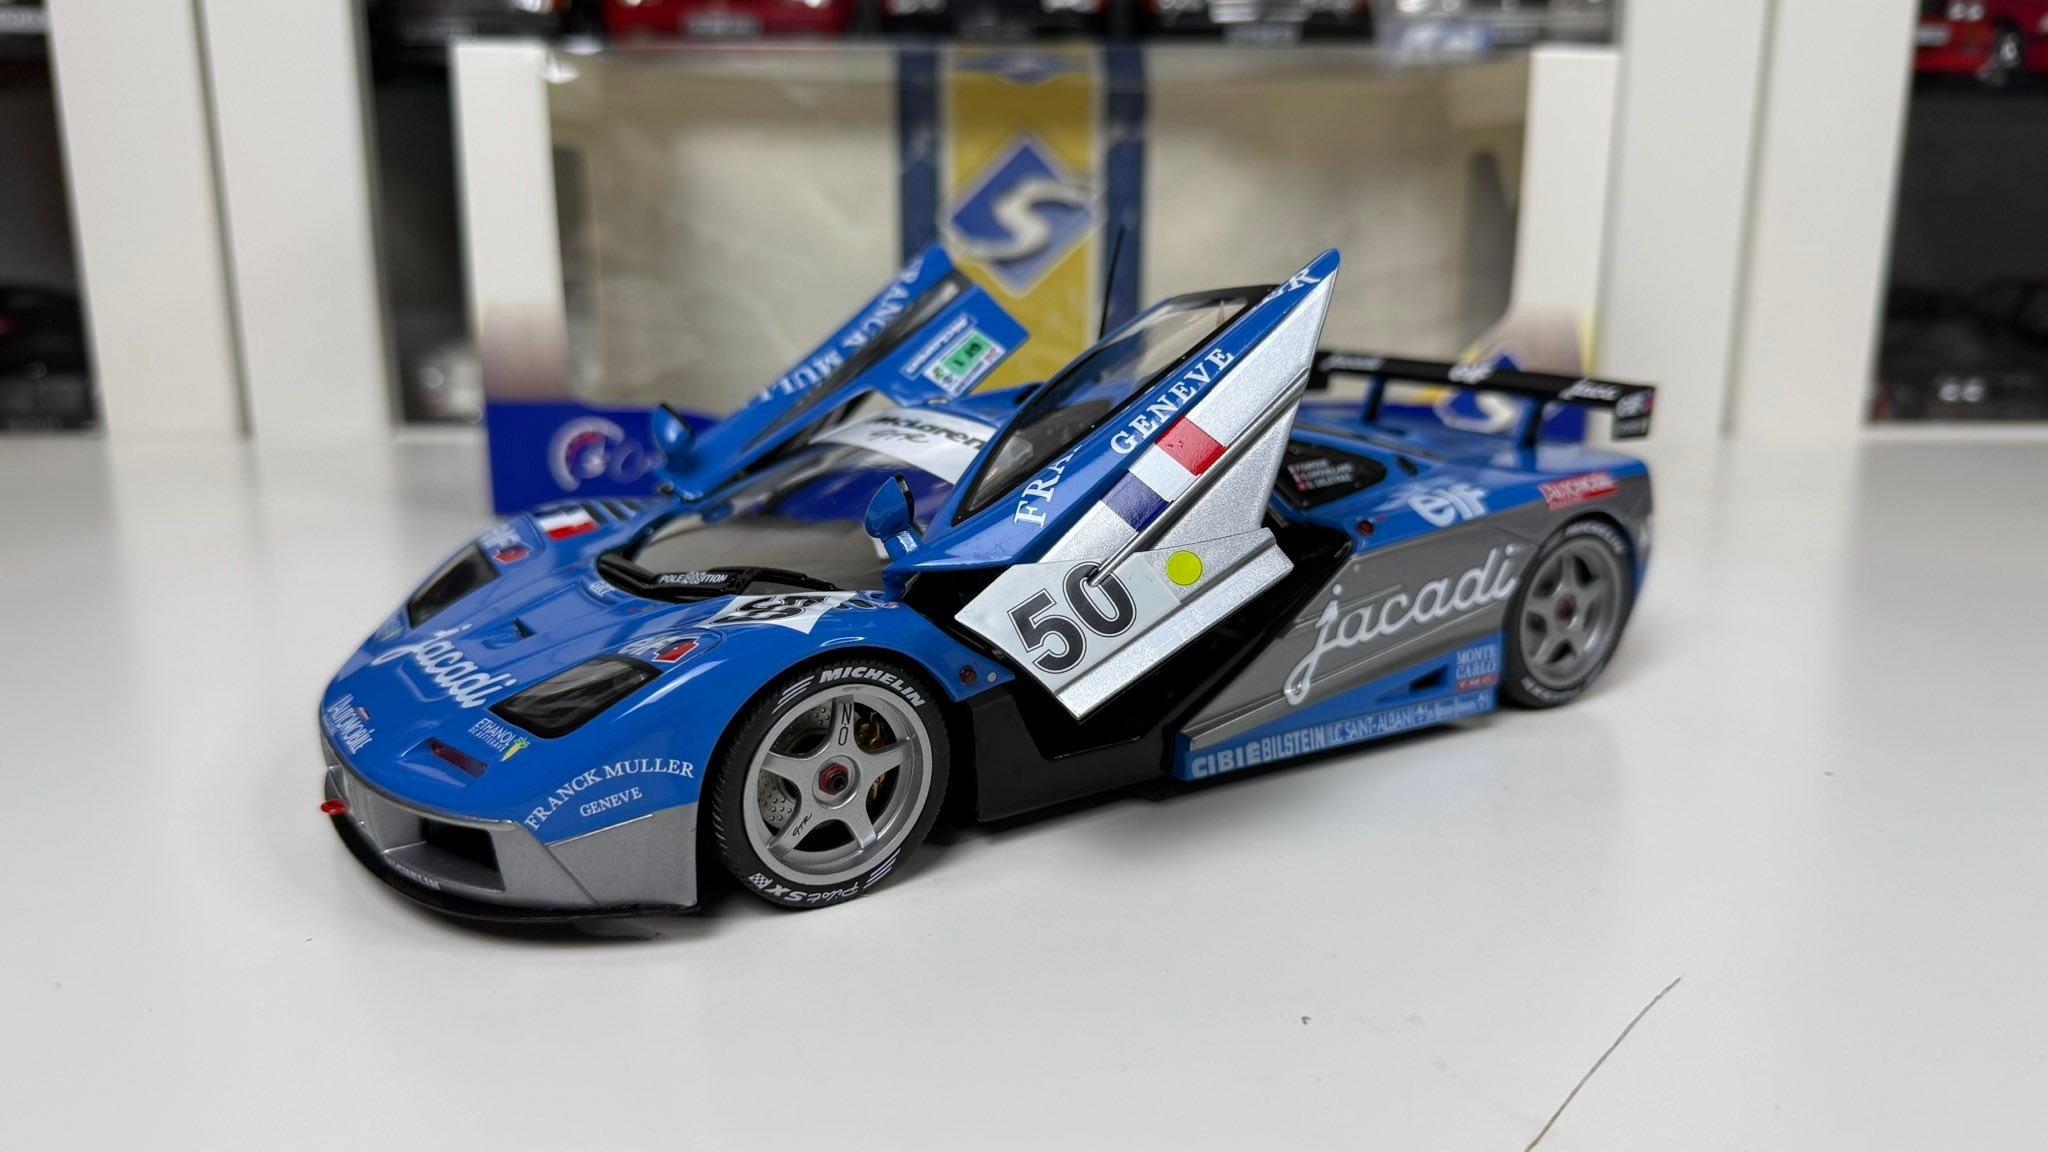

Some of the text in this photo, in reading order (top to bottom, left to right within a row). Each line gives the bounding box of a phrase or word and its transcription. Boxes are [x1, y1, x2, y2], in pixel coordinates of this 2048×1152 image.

[1110, 347, 1234, 455] GENEVE
[659, 574, 683, 584] POLE
[1007, 561, 1138, 674] 50
[1284, 544, 1519, 706] jacadi
[371, 622, 518, 709] jacadi
[819, 666, 926, 708] MICHELIN
[474, 717, 517, 747] ETHANOL
[1261, 725, 1326, 763] BILSTEIN
[524, 758, 695, 831] FRANCK MULLER
[579, 786, 643, 817] GENEVE
